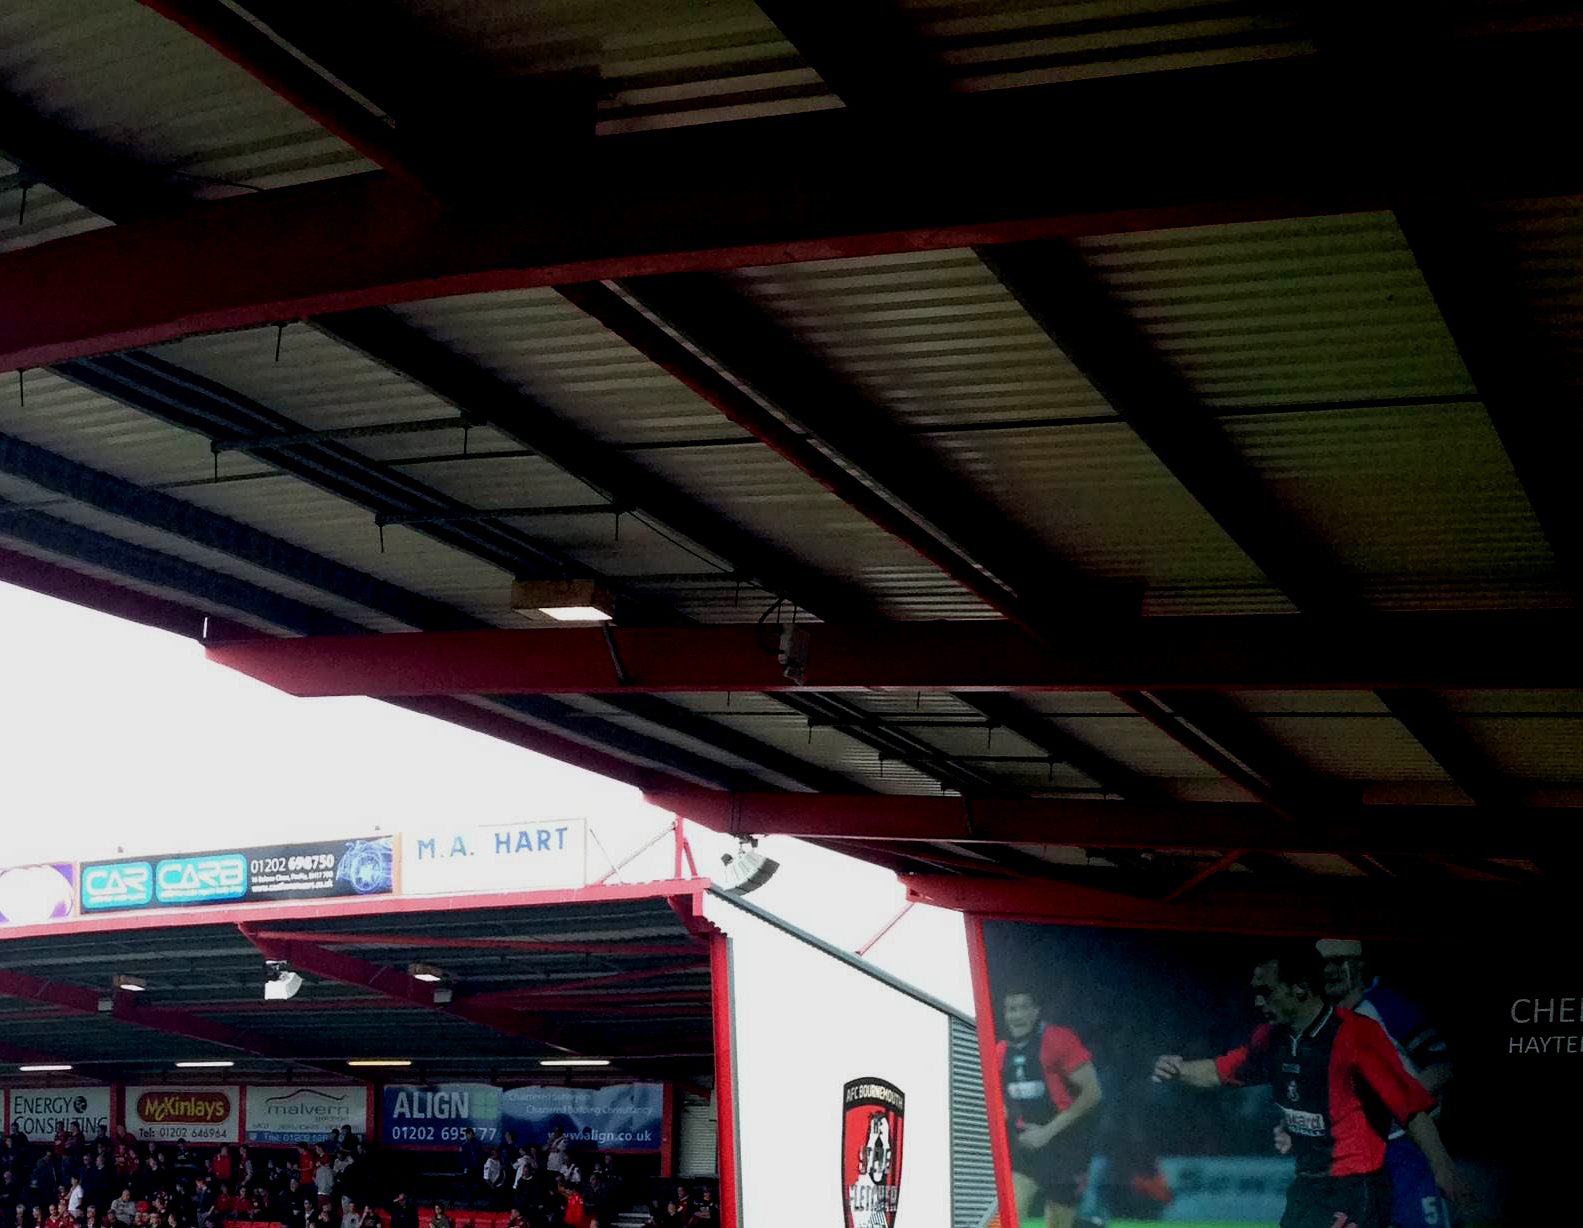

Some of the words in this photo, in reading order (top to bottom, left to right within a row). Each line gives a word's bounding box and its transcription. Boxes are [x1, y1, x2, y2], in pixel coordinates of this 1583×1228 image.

[495, 827, 568, 854] HART
[251, 857, 286, 874] 01202
[1511, 998, 1583, 1023] CHE
[1509, 1036, 1583, 1053] HAYTE
[13, 1096, 73, 1114] ENERGY
[393, 1091, 469, 1119] ALIGN
[846, 1086, 858, 1103] AFC
[859, 1084, 904, 1109] BOURNEMOUTH
[145, 1097, 225, 1121] McKinlays
[268, 1103, 349, 1115] malvern
[139, 1128, 155, 1138] Tel:
[159, 1128, 187, 1138] 01202
[191, 1128, 227, 1138] 646964
[392, 1126, 435, 1140] 01202
